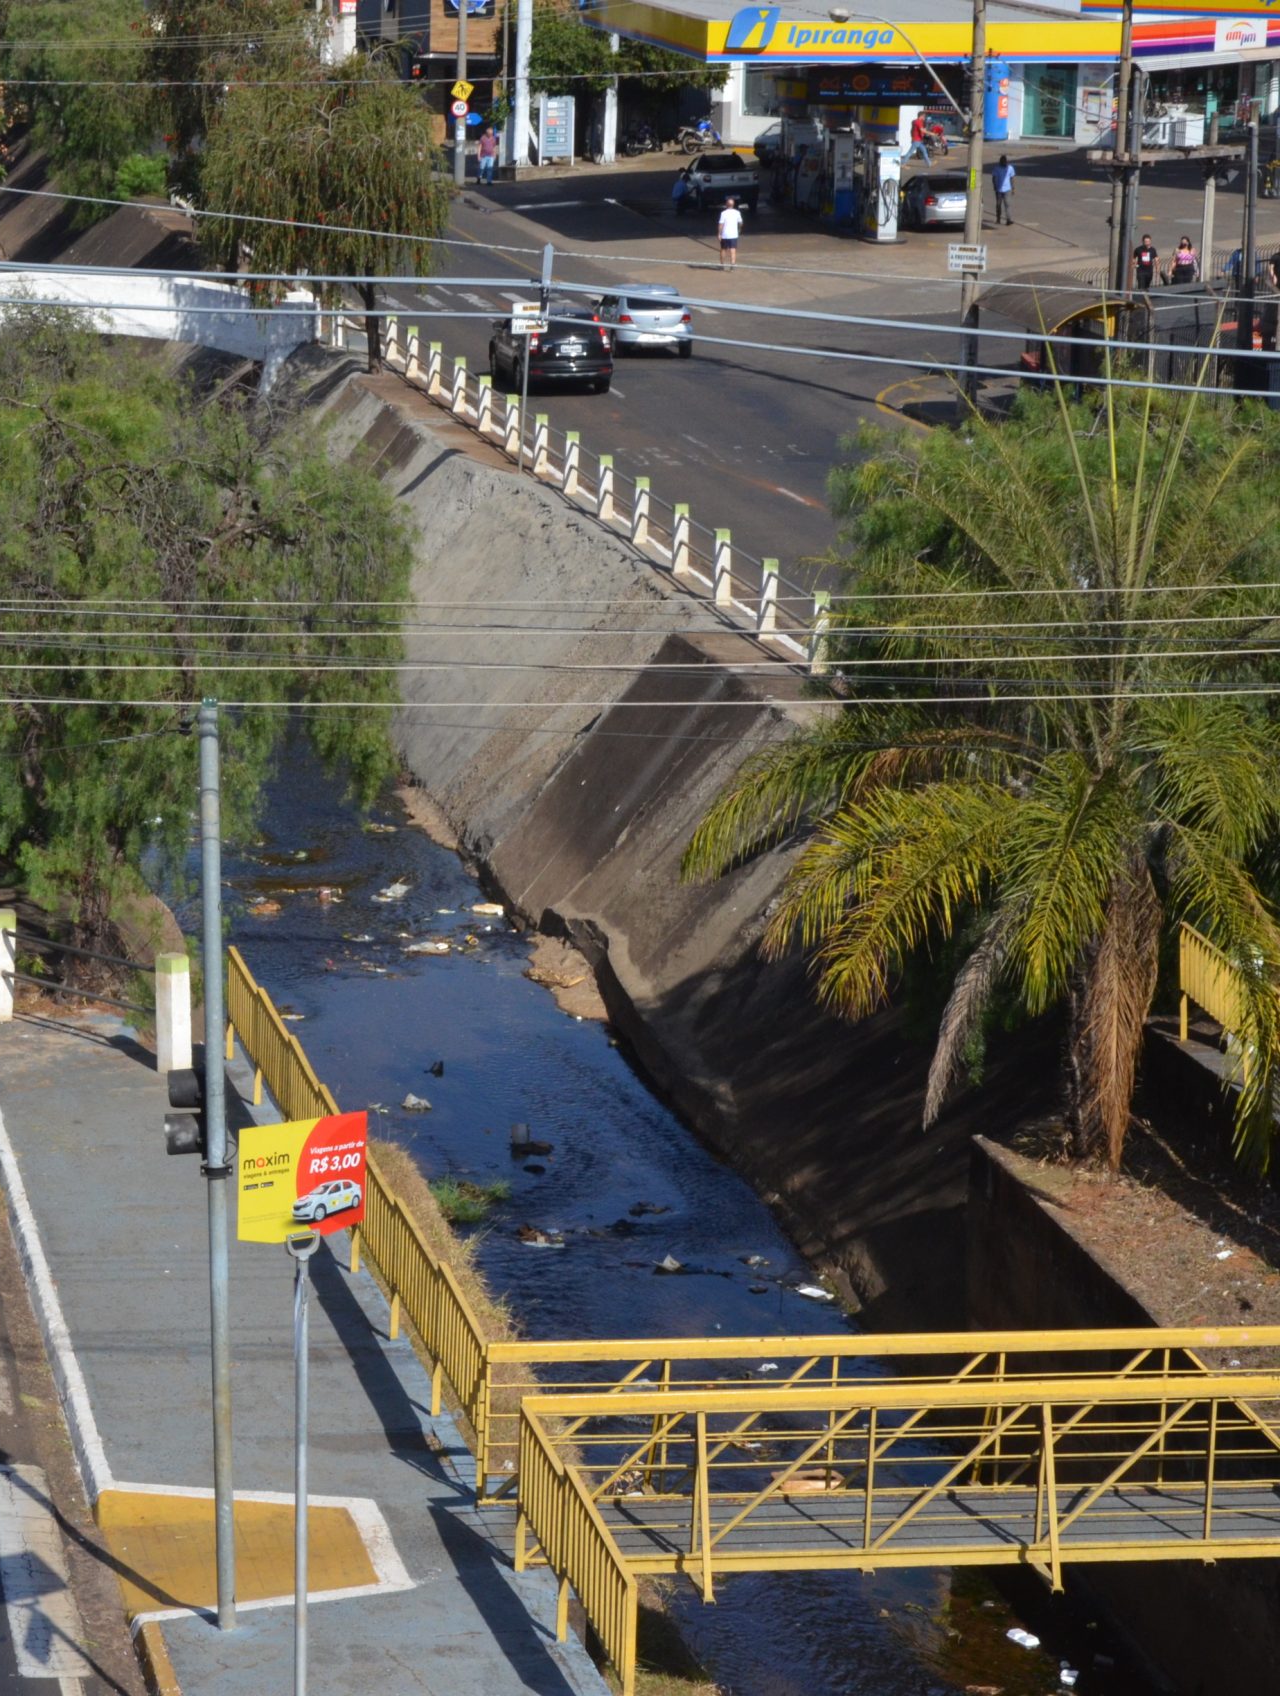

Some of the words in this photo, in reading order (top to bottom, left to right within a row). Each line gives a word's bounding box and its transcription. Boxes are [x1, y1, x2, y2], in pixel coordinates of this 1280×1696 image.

[787, 25, 894, 49] Ipiranga
[1225, 31, 1256, 46] ampm
[455, 103, 466, 112] 40
[310, 1146, 333, 1154] Viagens
[339, 1142, 356, 1151] partir
[356, 1140, 364, 1148] de
[243, 1152, 290, 1170] maxim
